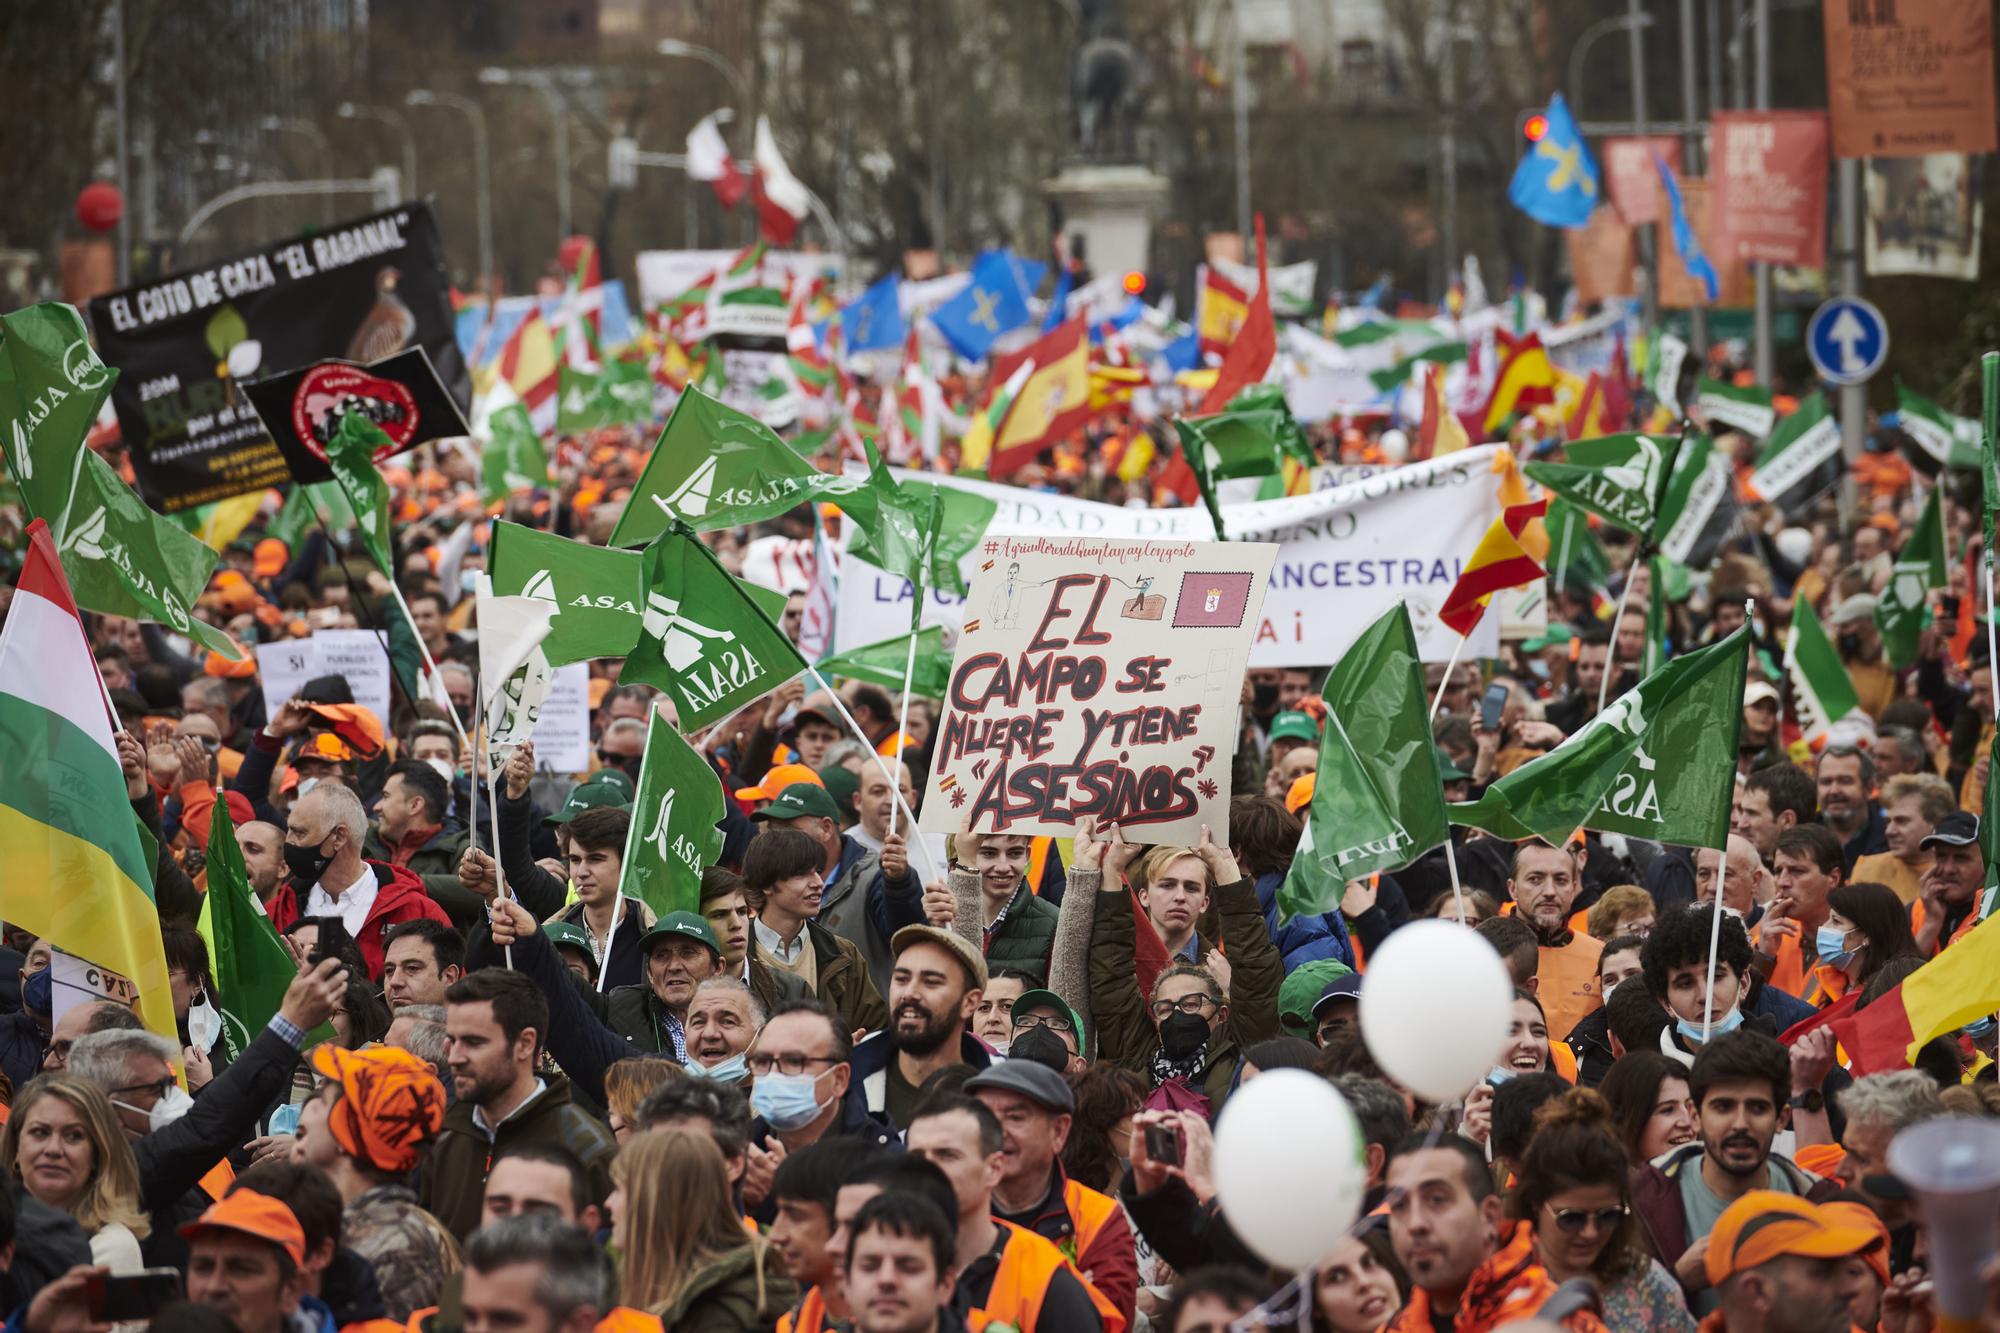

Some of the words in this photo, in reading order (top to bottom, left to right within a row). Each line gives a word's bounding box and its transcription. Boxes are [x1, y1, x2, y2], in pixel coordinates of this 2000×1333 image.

[109, 295, 138, 332] EL
[137, 279, 193, 325] COTO
[190, 271, 223, 308] DE
[219, 254, 276, 298] CAZA
[715, 476, 800, 506] ASAJA
[568, 594, 642, 615] ASA
[1026, 573, 1112, 653] EL
[950, 651, 1107, 714] CAMPO
[1115, 654, 1172, 695] SE
[936, 708, 1064, 775] MUERE
